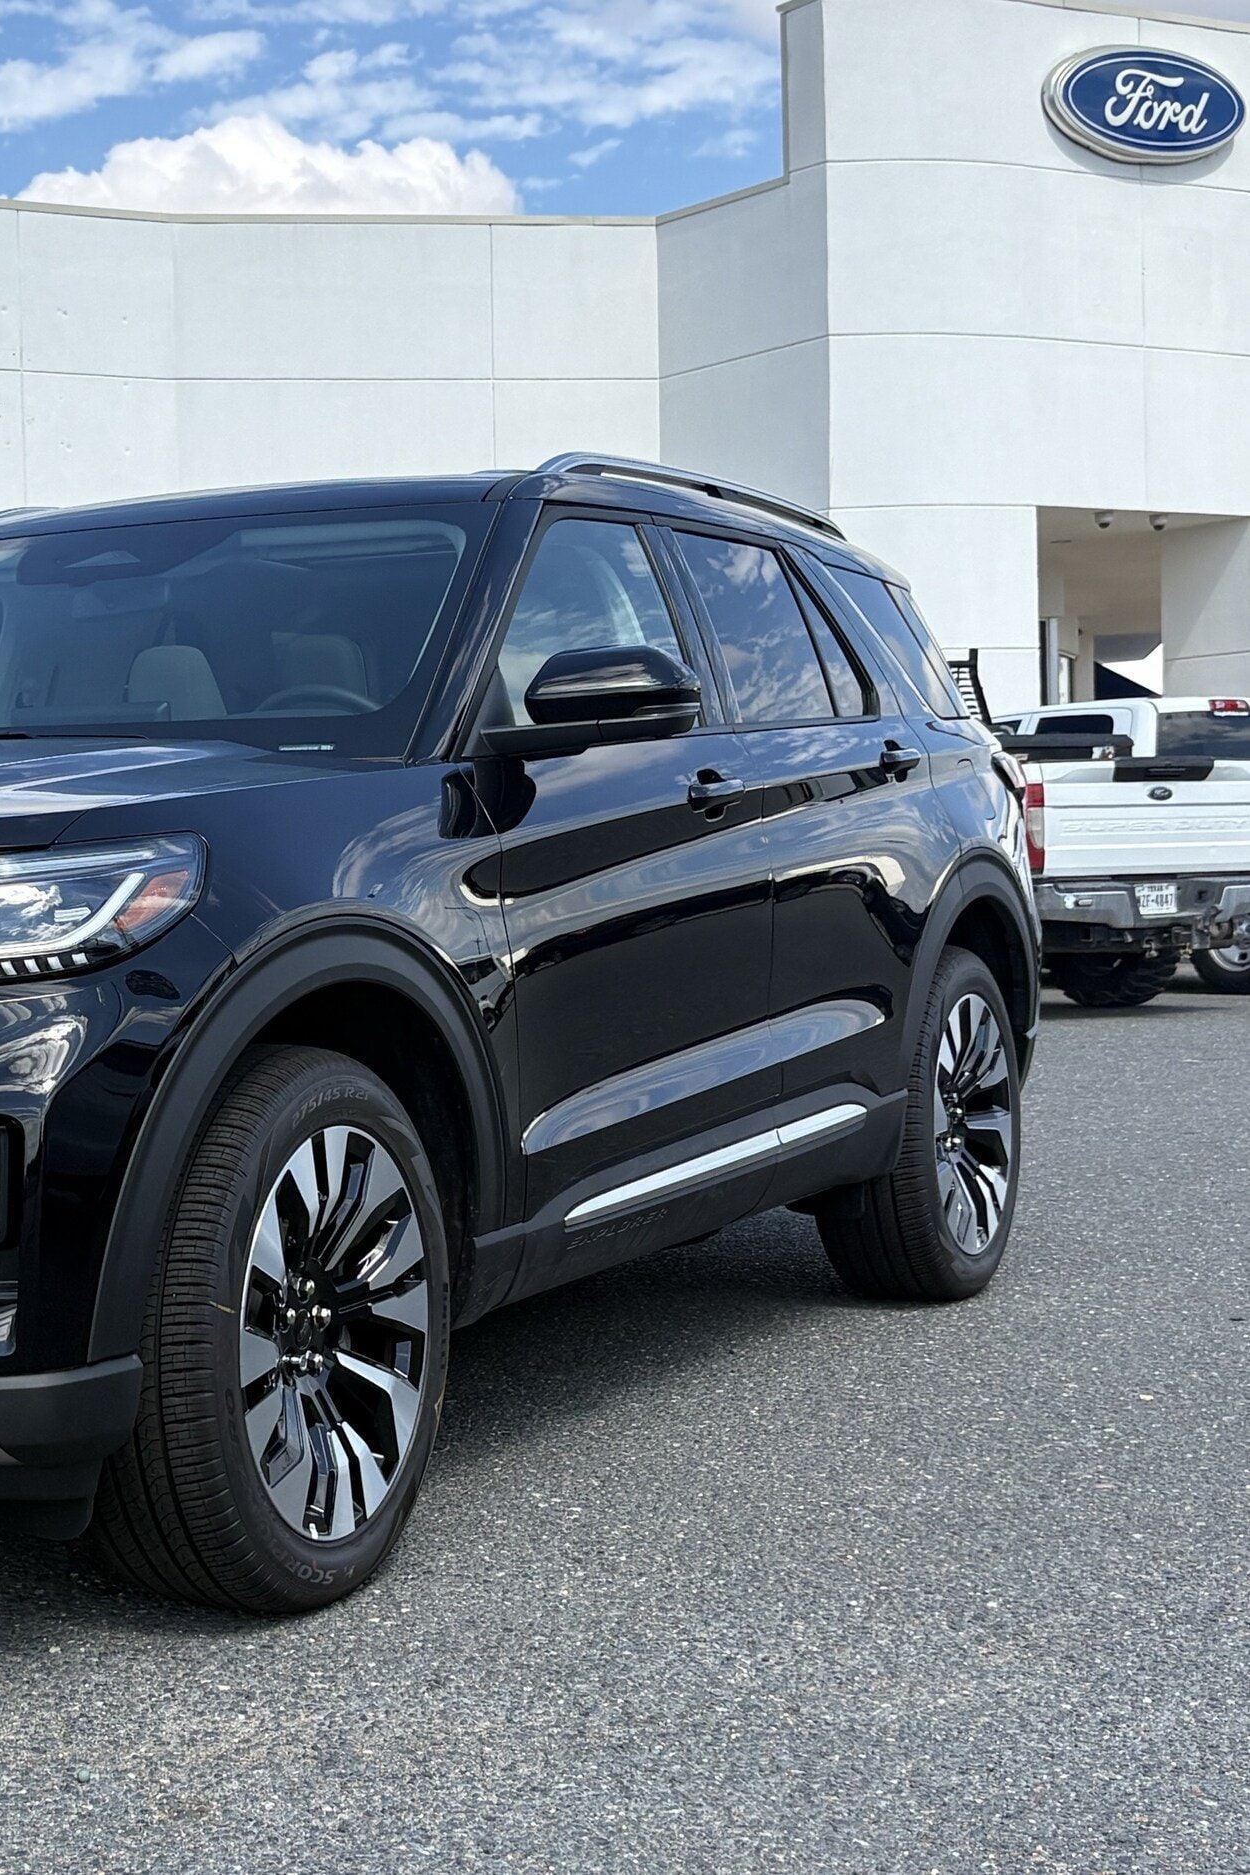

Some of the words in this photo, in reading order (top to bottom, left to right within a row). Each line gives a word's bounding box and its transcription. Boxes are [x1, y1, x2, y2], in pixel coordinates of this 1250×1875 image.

[1104, 68, 1210, 134] Ford
[1063, 822, 1165, 833] SUPER
[1174, 819, 1248, 831] DUTY
